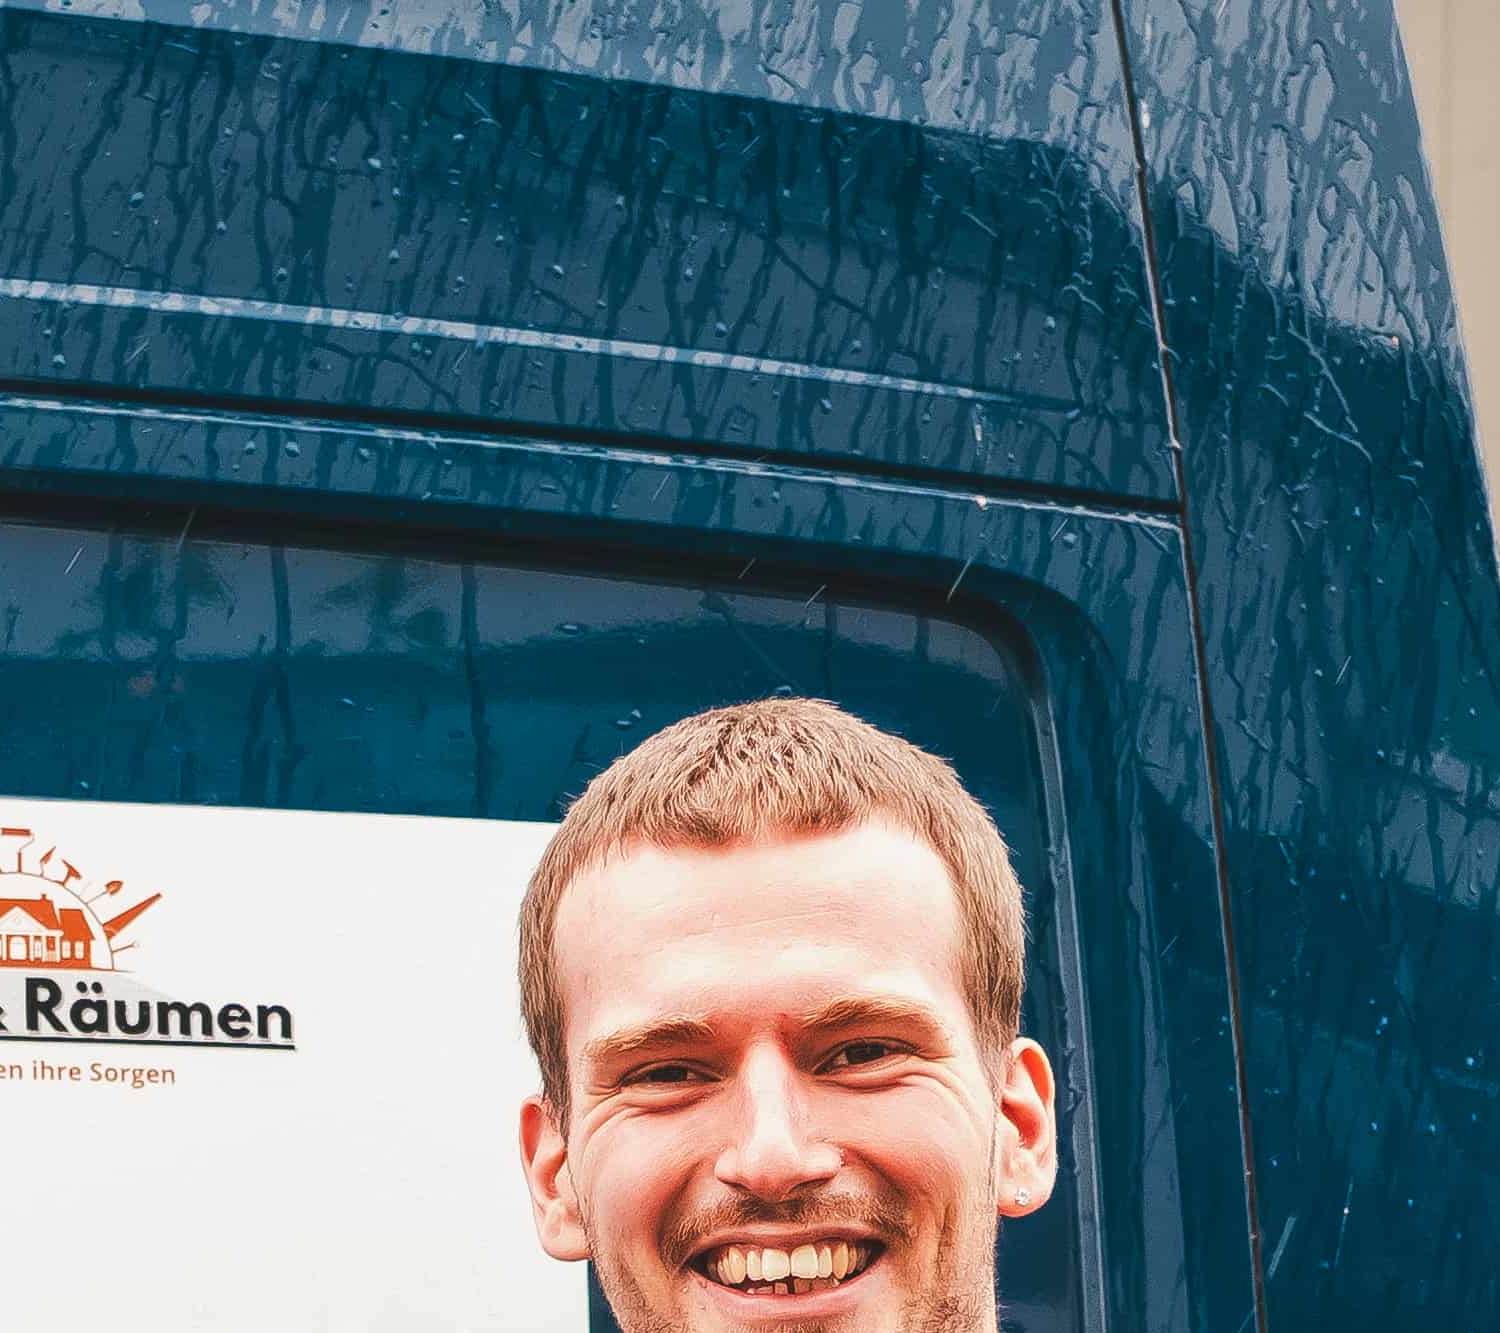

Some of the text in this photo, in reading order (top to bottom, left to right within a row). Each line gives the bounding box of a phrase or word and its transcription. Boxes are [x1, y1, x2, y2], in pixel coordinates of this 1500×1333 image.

[24, 976, 294, 1040] Räumen
[31, 1058, 82, 1083] ihre
[88, 1061, 177, 1091] Sorgen
